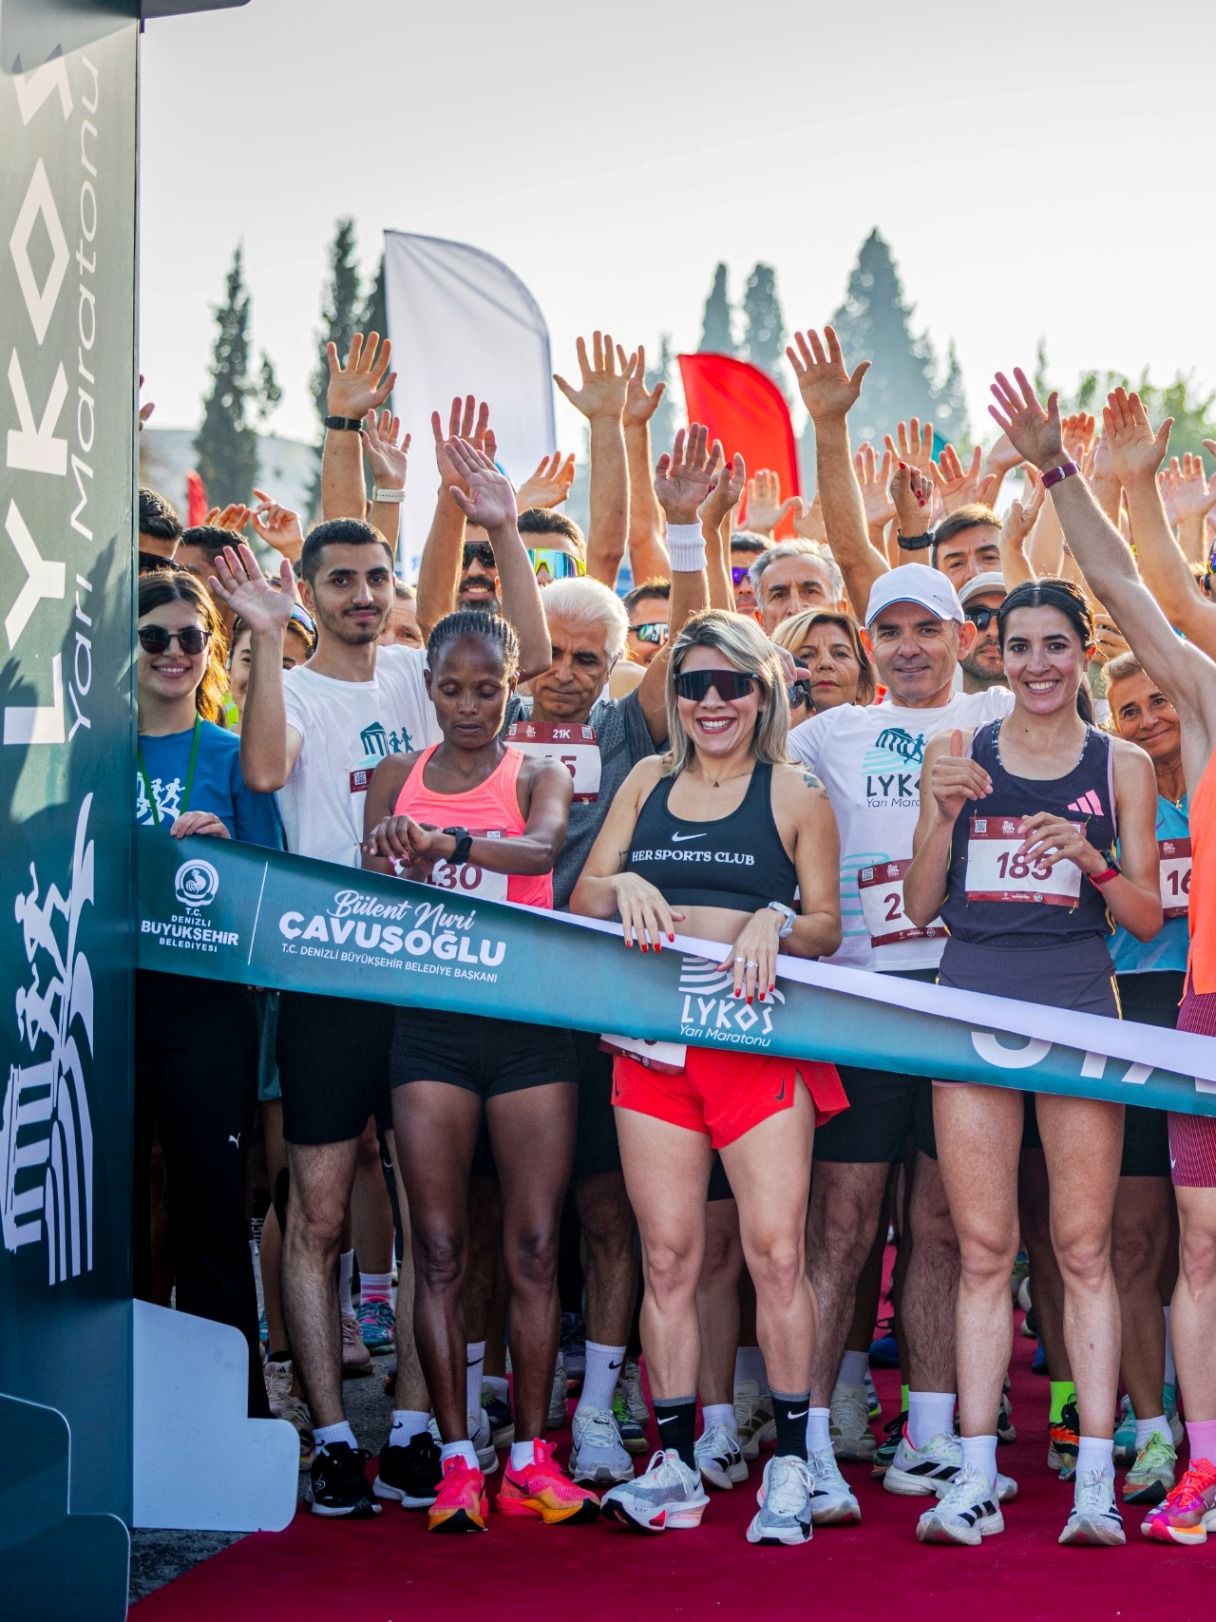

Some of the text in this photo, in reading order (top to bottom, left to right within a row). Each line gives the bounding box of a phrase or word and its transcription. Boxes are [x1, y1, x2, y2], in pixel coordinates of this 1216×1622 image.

[70, 55, 99, 542] Maratonu
[4, 43, 73, 745] LYKOS
[552, 728, 572, 739] 21K
[866, 774, 920, 798] LYK
[631, 849, 755, 866] HER SPORTS CLUB
[326, 889, 476, 936] Bülent Nuri
[279, 911, 507, 967] ÇAVUŞOĞLU
[282, 943, 498, 983] T.C. DENİZLİ BÜYÜKŞEHİR BELEDİYE BAŞKANI
[681, 995, 774, 1035] LYKOS
[706, 1028, 772, 1047] Maratonu
